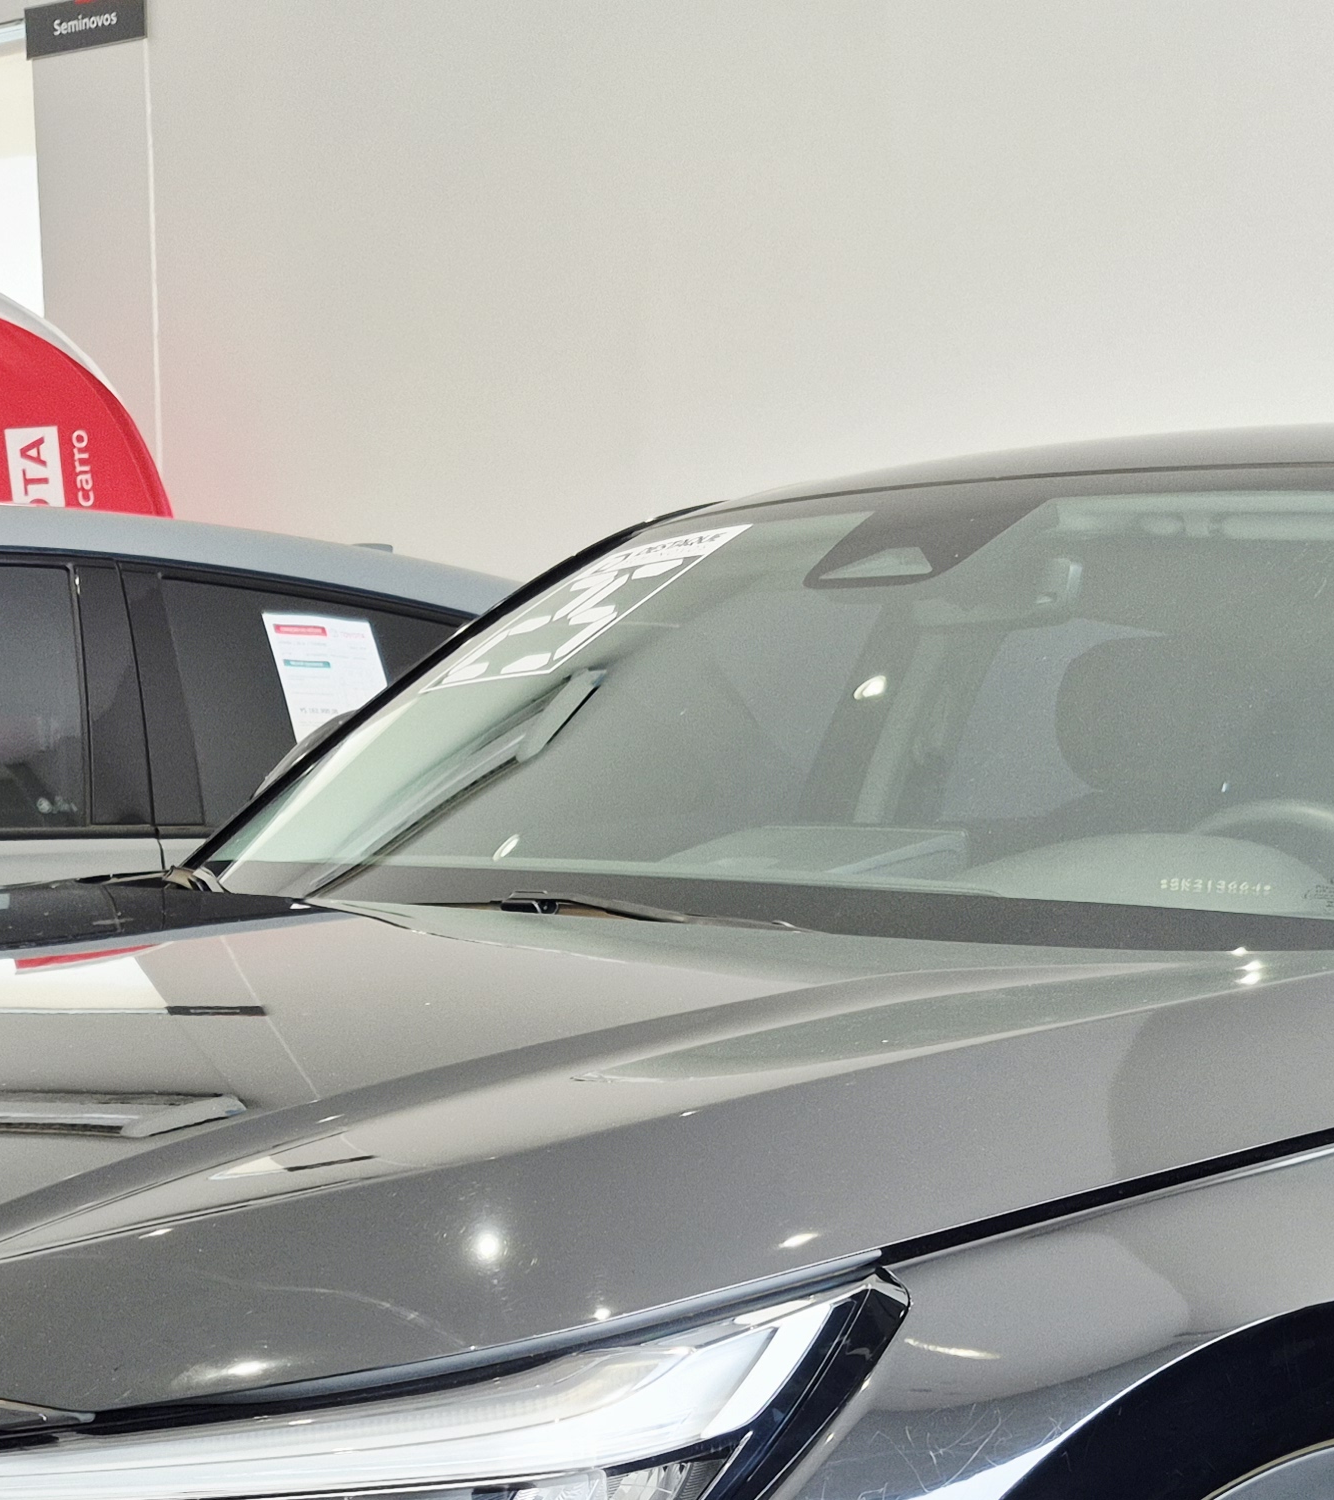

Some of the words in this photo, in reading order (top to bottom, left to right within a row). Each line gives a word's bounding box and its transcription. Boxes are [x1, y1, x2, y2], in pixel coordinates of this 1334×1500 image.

[53, 11, 118, 36] Seminovos
[19, 437, 50, 507] TA
[72, 429, 95, 506] carro
